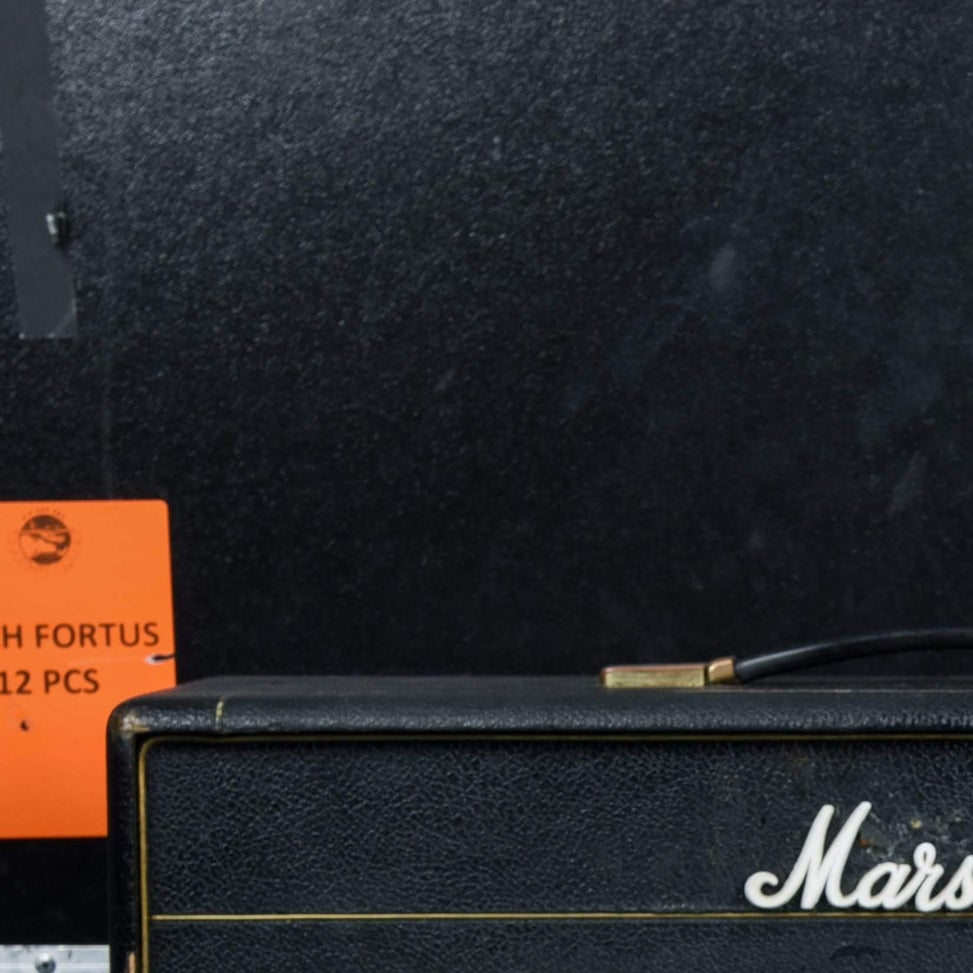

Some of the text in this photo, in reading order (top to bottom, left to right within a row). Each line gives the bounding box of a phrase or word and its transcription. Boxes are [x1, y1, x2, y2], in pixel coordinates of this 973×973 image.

[34, 621, 160, 649] FORTUS
[0, 668, 100, 696] 12 PCS
